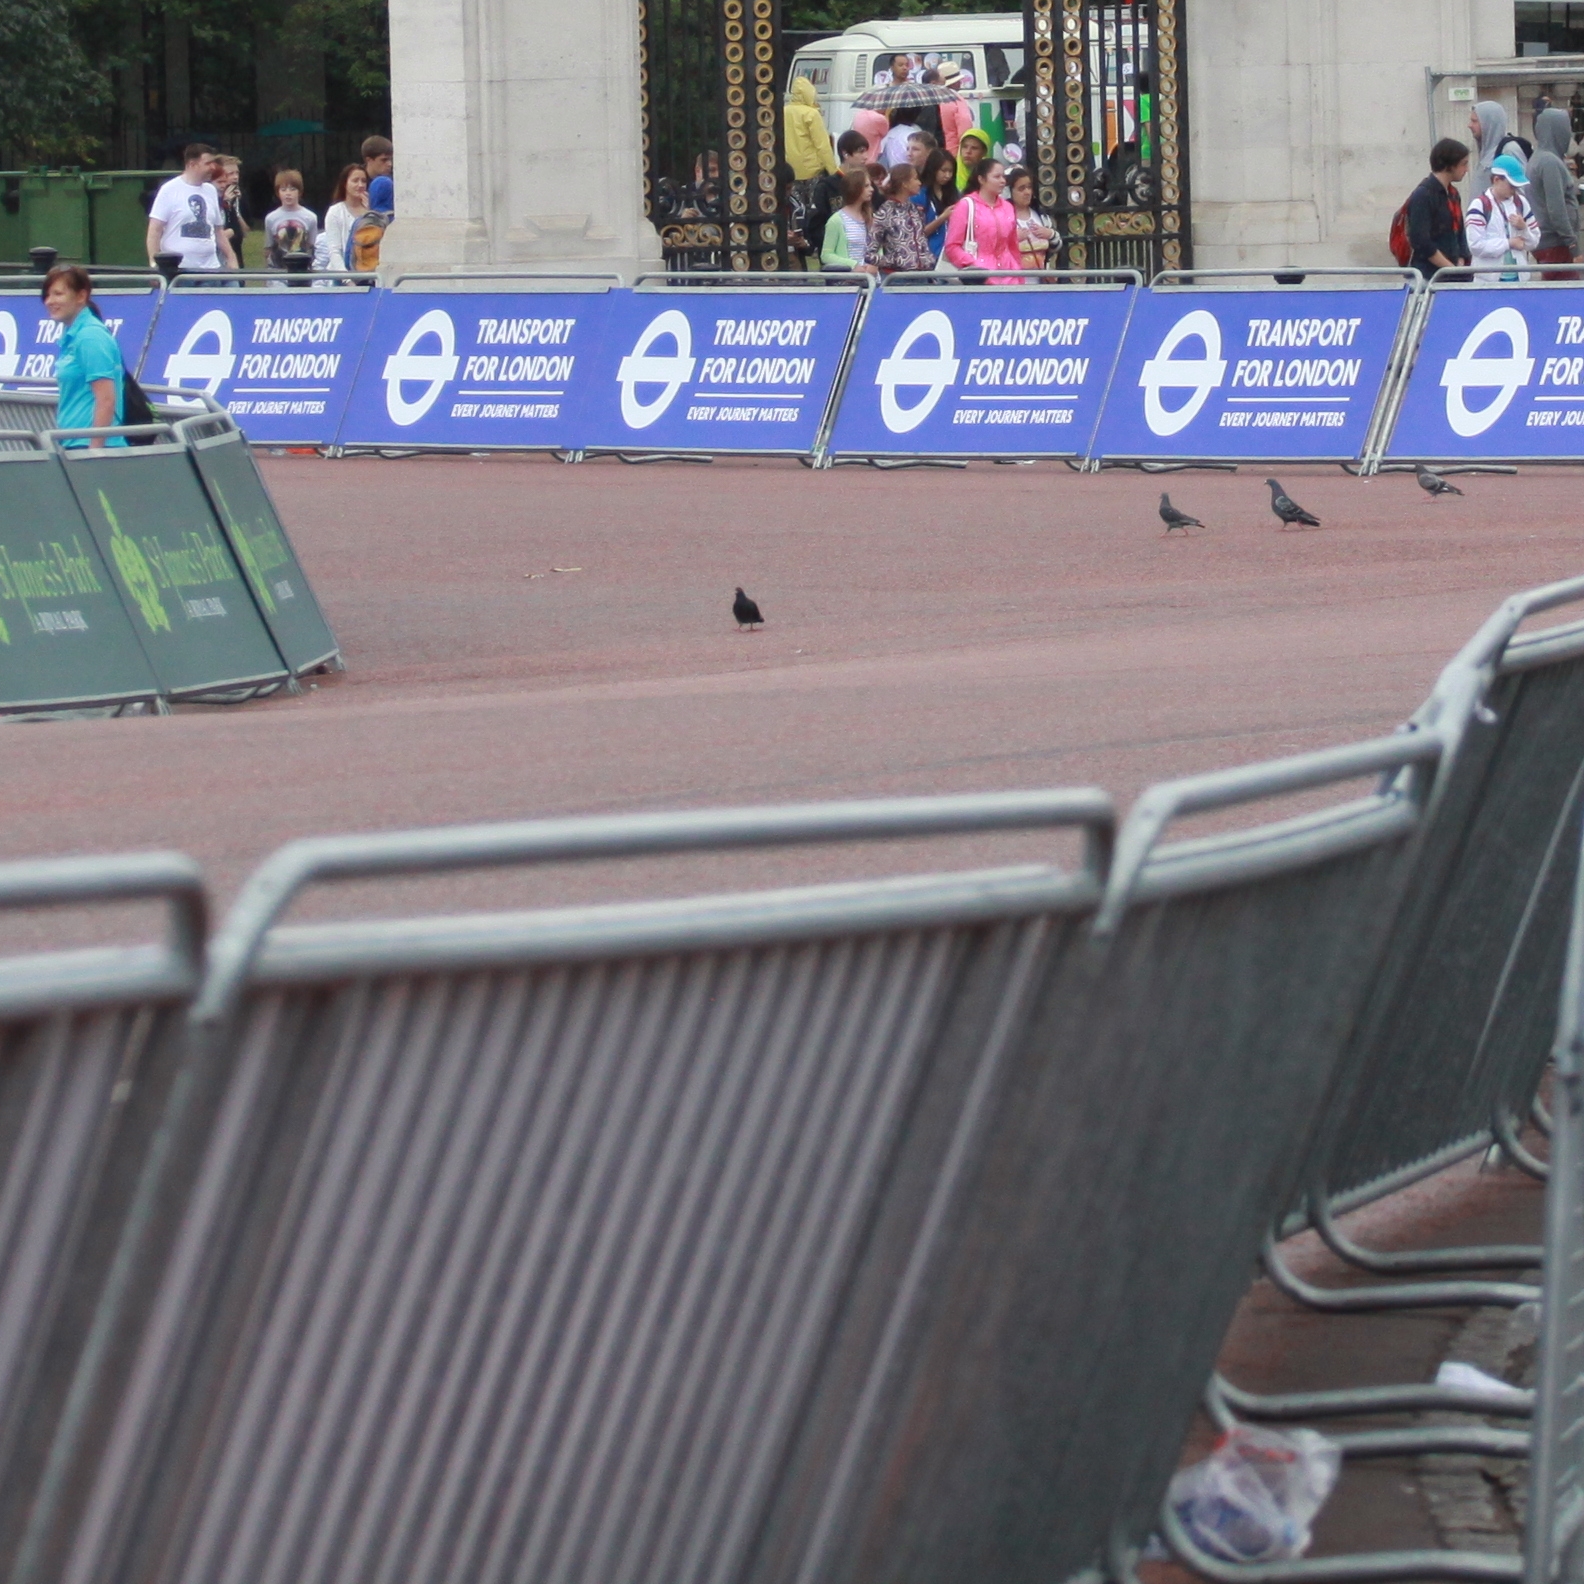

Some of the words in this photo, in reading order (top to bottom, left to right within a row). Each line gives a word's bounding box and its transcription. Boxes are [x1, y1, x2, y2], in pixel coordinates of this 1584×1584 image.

[251, 317, 343, 344] TRANSPORT
[476, 318, 576, 345] TRANSPORT
[713, 319, 817, 346] TRANSPORT
[978, 319, 1090, 346] TRANSPORT
[1247, 318, 1362, 347] TRANSPORT
[22, 353, 56, 377] FOR
[237, 353, 271, 380] FOR
[270, 353, 341, 380] LONDON
[462, 355, 499, 382] FOR
[497, 355, 576, 382] LONDON
[698, 358, 736, 384] FOR
[735, 357, 816, 384] LONDON
[964, 358, 1005, 385] FOR
[1003, 358, 1090, 385] LONDON
[1231, 359, 1275, 387] FOR
[1273, 358, 1362, 386] LONDON
[1539, 356, 1584, 386] FOR
[226, 400, 254, 414] EVERY
[251, 401, 291, 415] JOURNEY
[288, 401, 326, 415] MATTERS
[450, 403, 481, 418] EVERY
[478, 404, 522, 419] JOURNEY
[519, 404, 560, 419] MATTERS
[686, 406, 718, 421] EVERY
[715, 407, 760, 422] JOURNEY
[757, 407, 800, 422] MATTERS
[952, 409, 986, 424] EVERY
[984, 410, 1031, 424] JOURNEY
[1029, 409, 1073, 424] MATTERS
[1218, 411, 1253, 427] EVERY
[1251, 412, 1301, 427] JOURNEY
[1299, 412, 1346, 427] MATTERS
[1526, 410, 1563, 427] EVERY
[49, 533, 103, 595] Park
